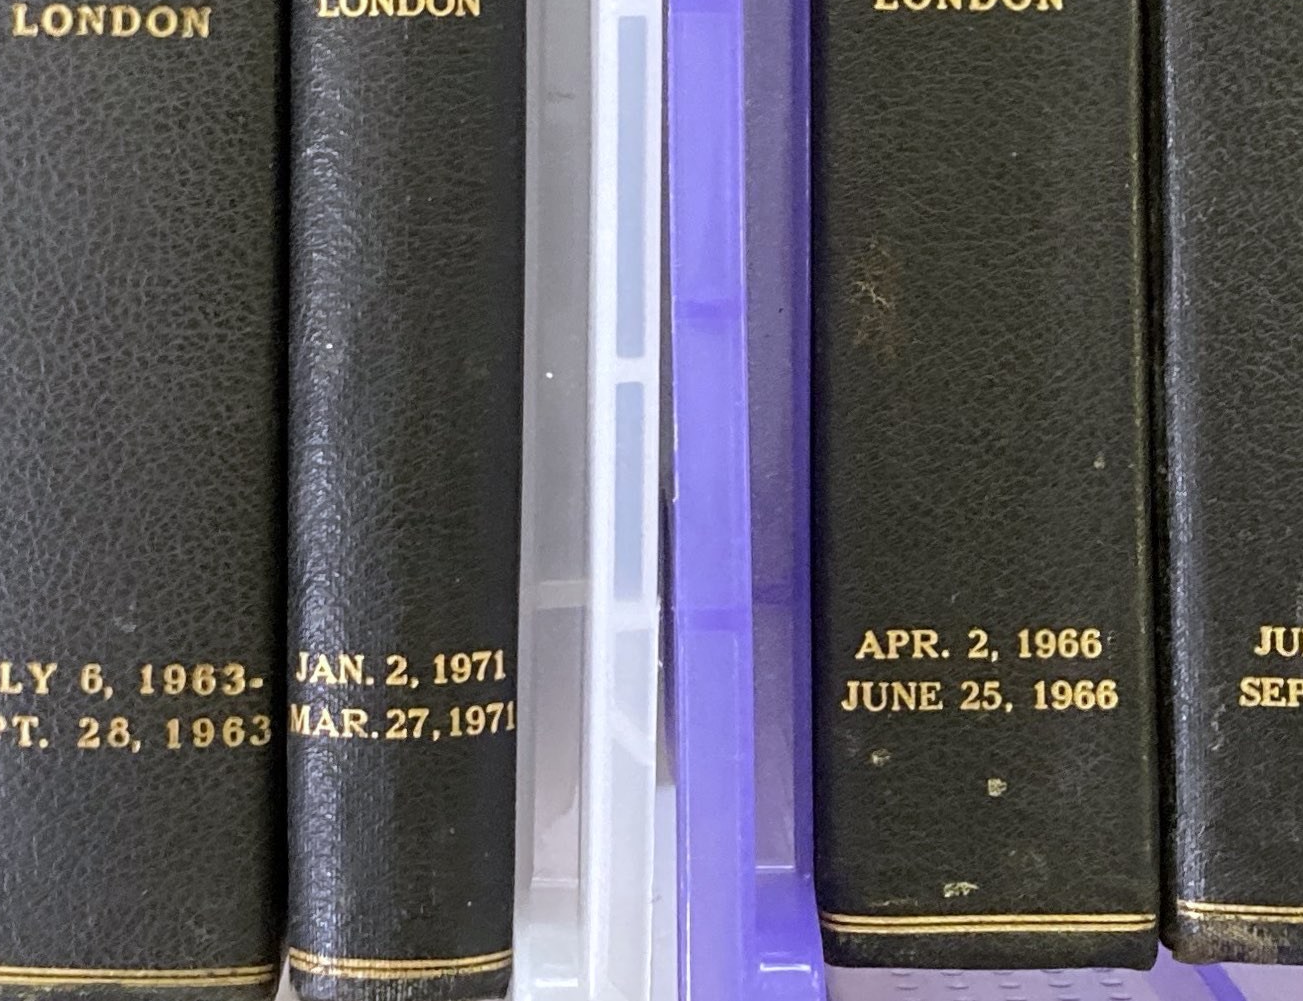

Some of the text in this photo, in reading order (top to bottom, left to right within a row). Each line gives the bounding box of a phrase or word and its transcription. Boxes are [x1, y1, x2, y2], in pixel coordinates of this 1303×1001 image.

[11, 1, 212, 38] LONDON
[855, 627, 1102, 662] APR. 2, 1966
[80, 663, 113, 700] 6,
[140, 663, 263, 696] 1963-
[296, 649, 504, 688] JAN. 2, 1971
[841, 679, 1118, 713] JUNE 25, 1966
[77, 717, 141, 753] 28,
[166, 715, 270, 749] 1963
[291, 702, 514, 741] MAR. 27, 1971
